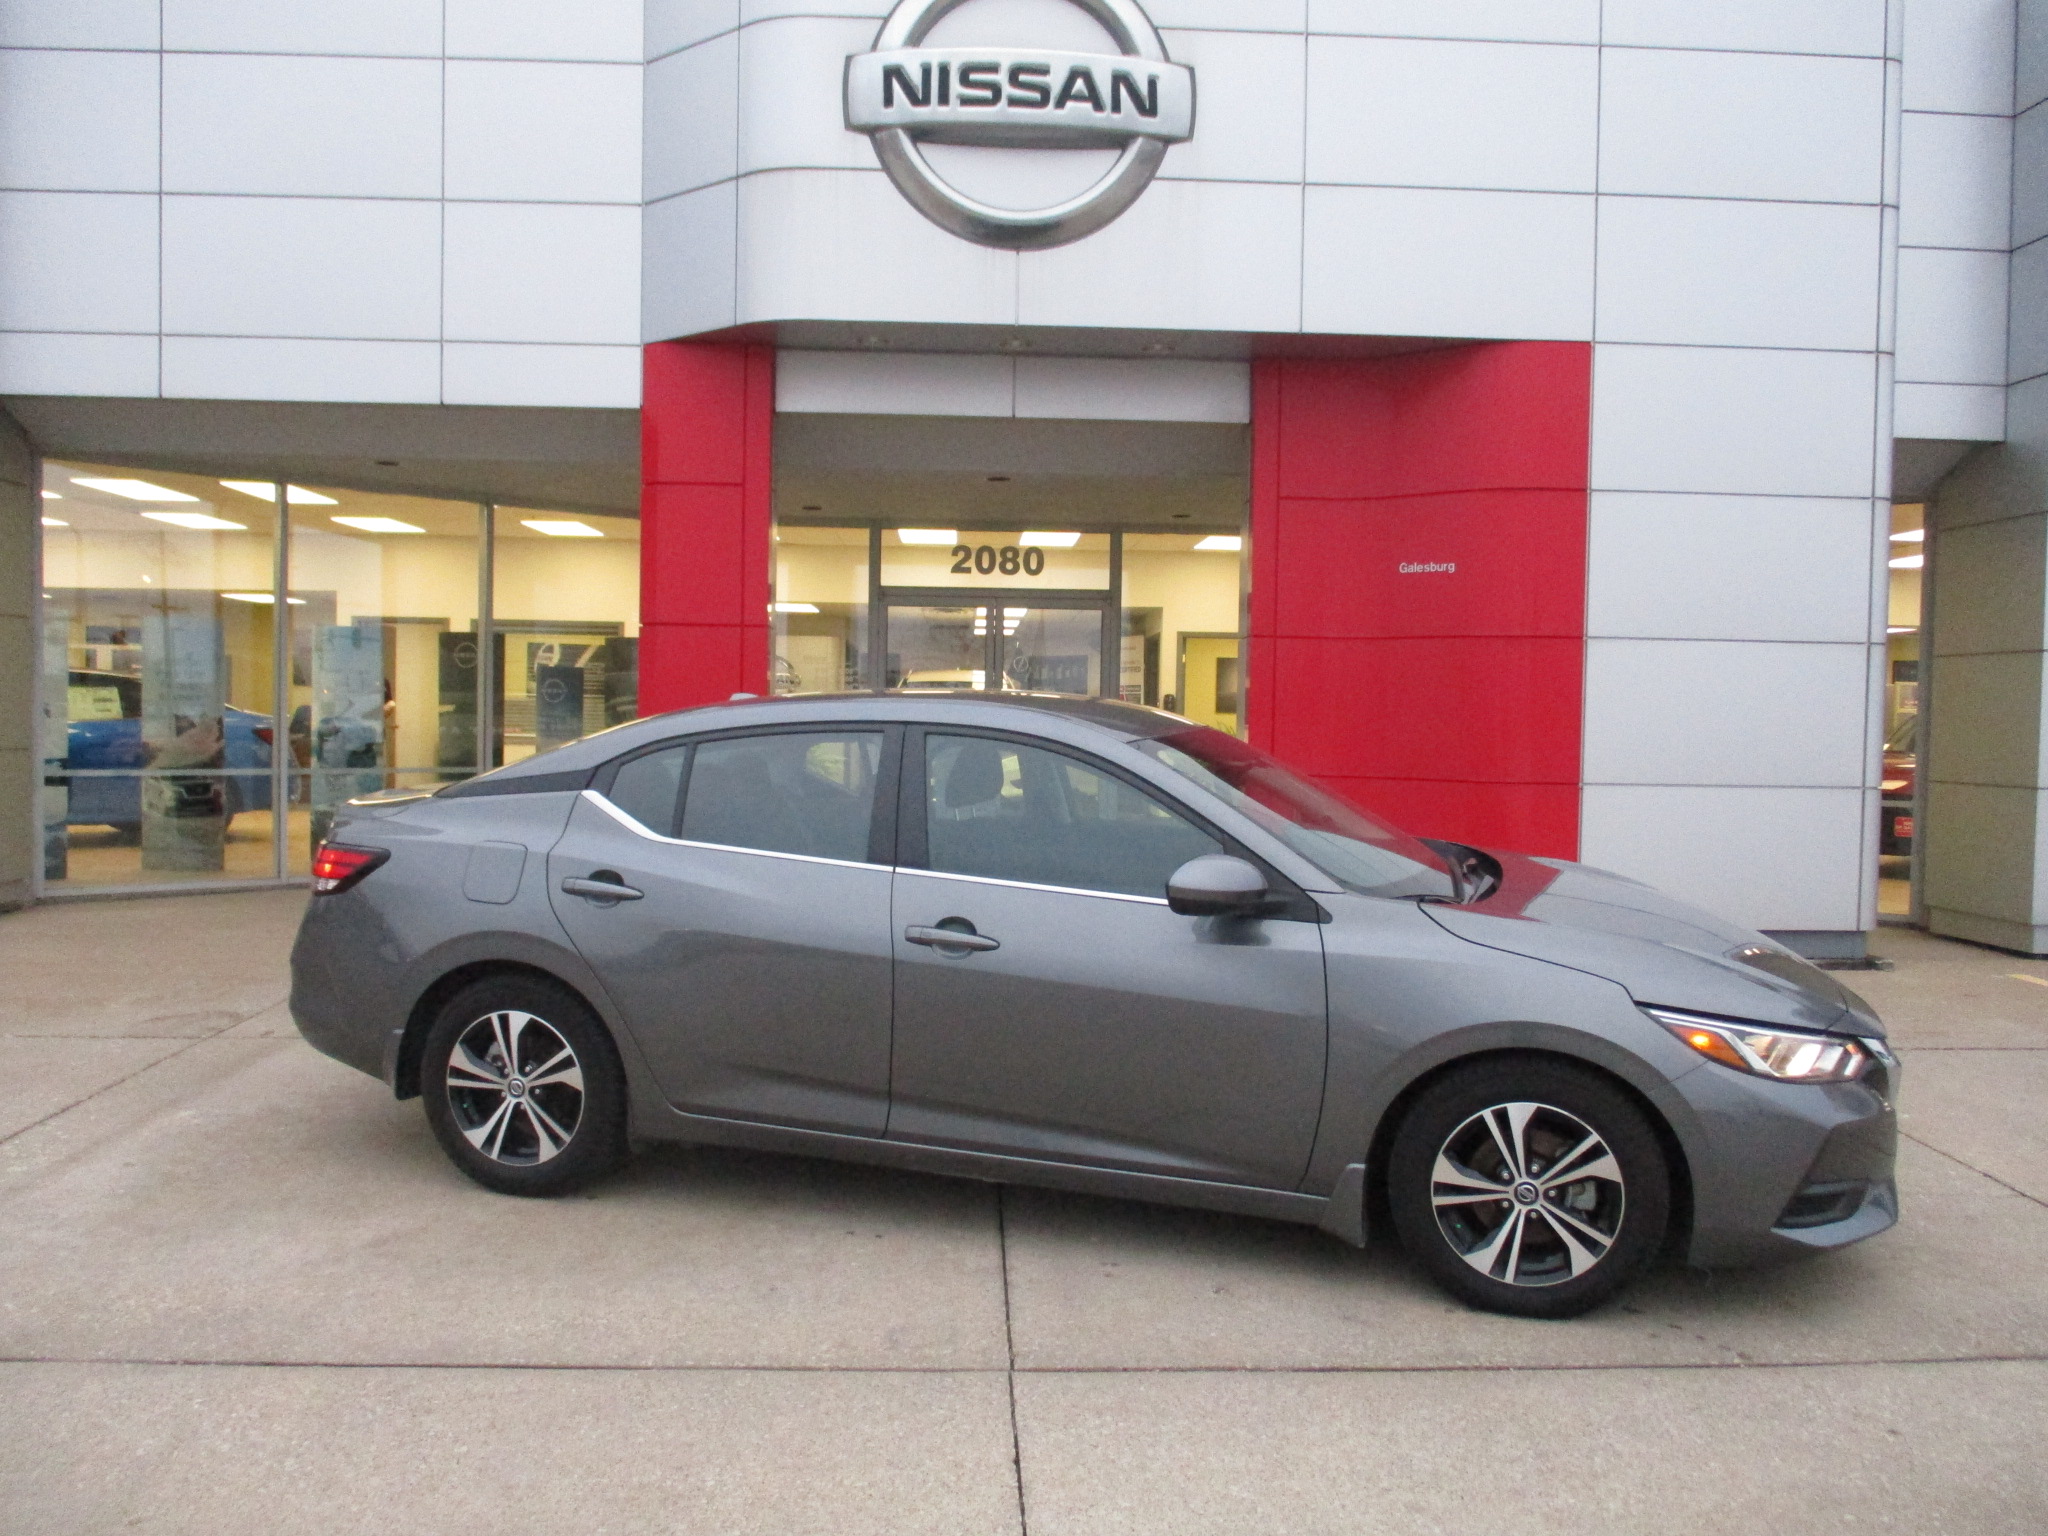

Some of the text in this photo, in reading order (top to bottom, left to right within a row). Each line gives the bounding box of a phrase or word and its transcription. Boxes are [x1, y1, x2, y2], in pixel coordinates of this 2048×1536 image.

[883, 61, 1159, 119] NISSAN
[950, 544, 1045, 577] 2080
[1398, 562, 1456, 574] Galesburg
